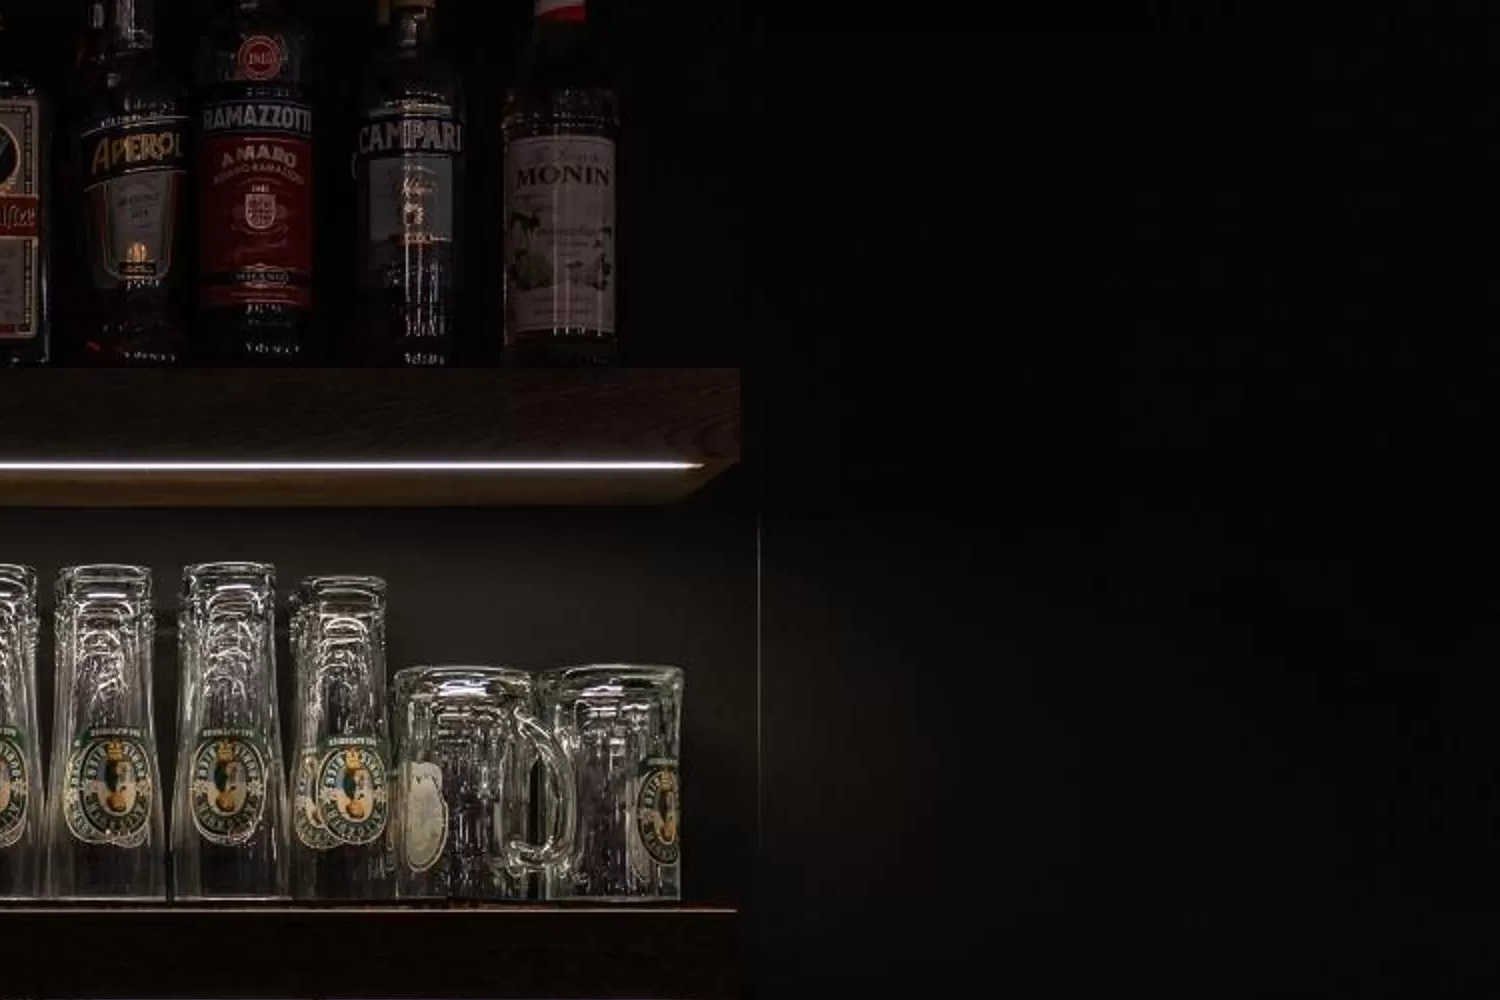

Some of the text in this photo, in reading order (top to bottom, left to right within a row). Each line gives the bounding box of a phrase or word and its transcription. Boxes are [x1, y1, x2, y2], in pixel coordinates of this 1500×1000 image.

[203, 103, 313, 131] RAMAZZOTTI
[357, 119, 465, 154] CAMPARI
[91, 131, 184, 176] APEROL
[220, 143, 298, 170] AMARO
[516, 164, 610, 190] MONIN
